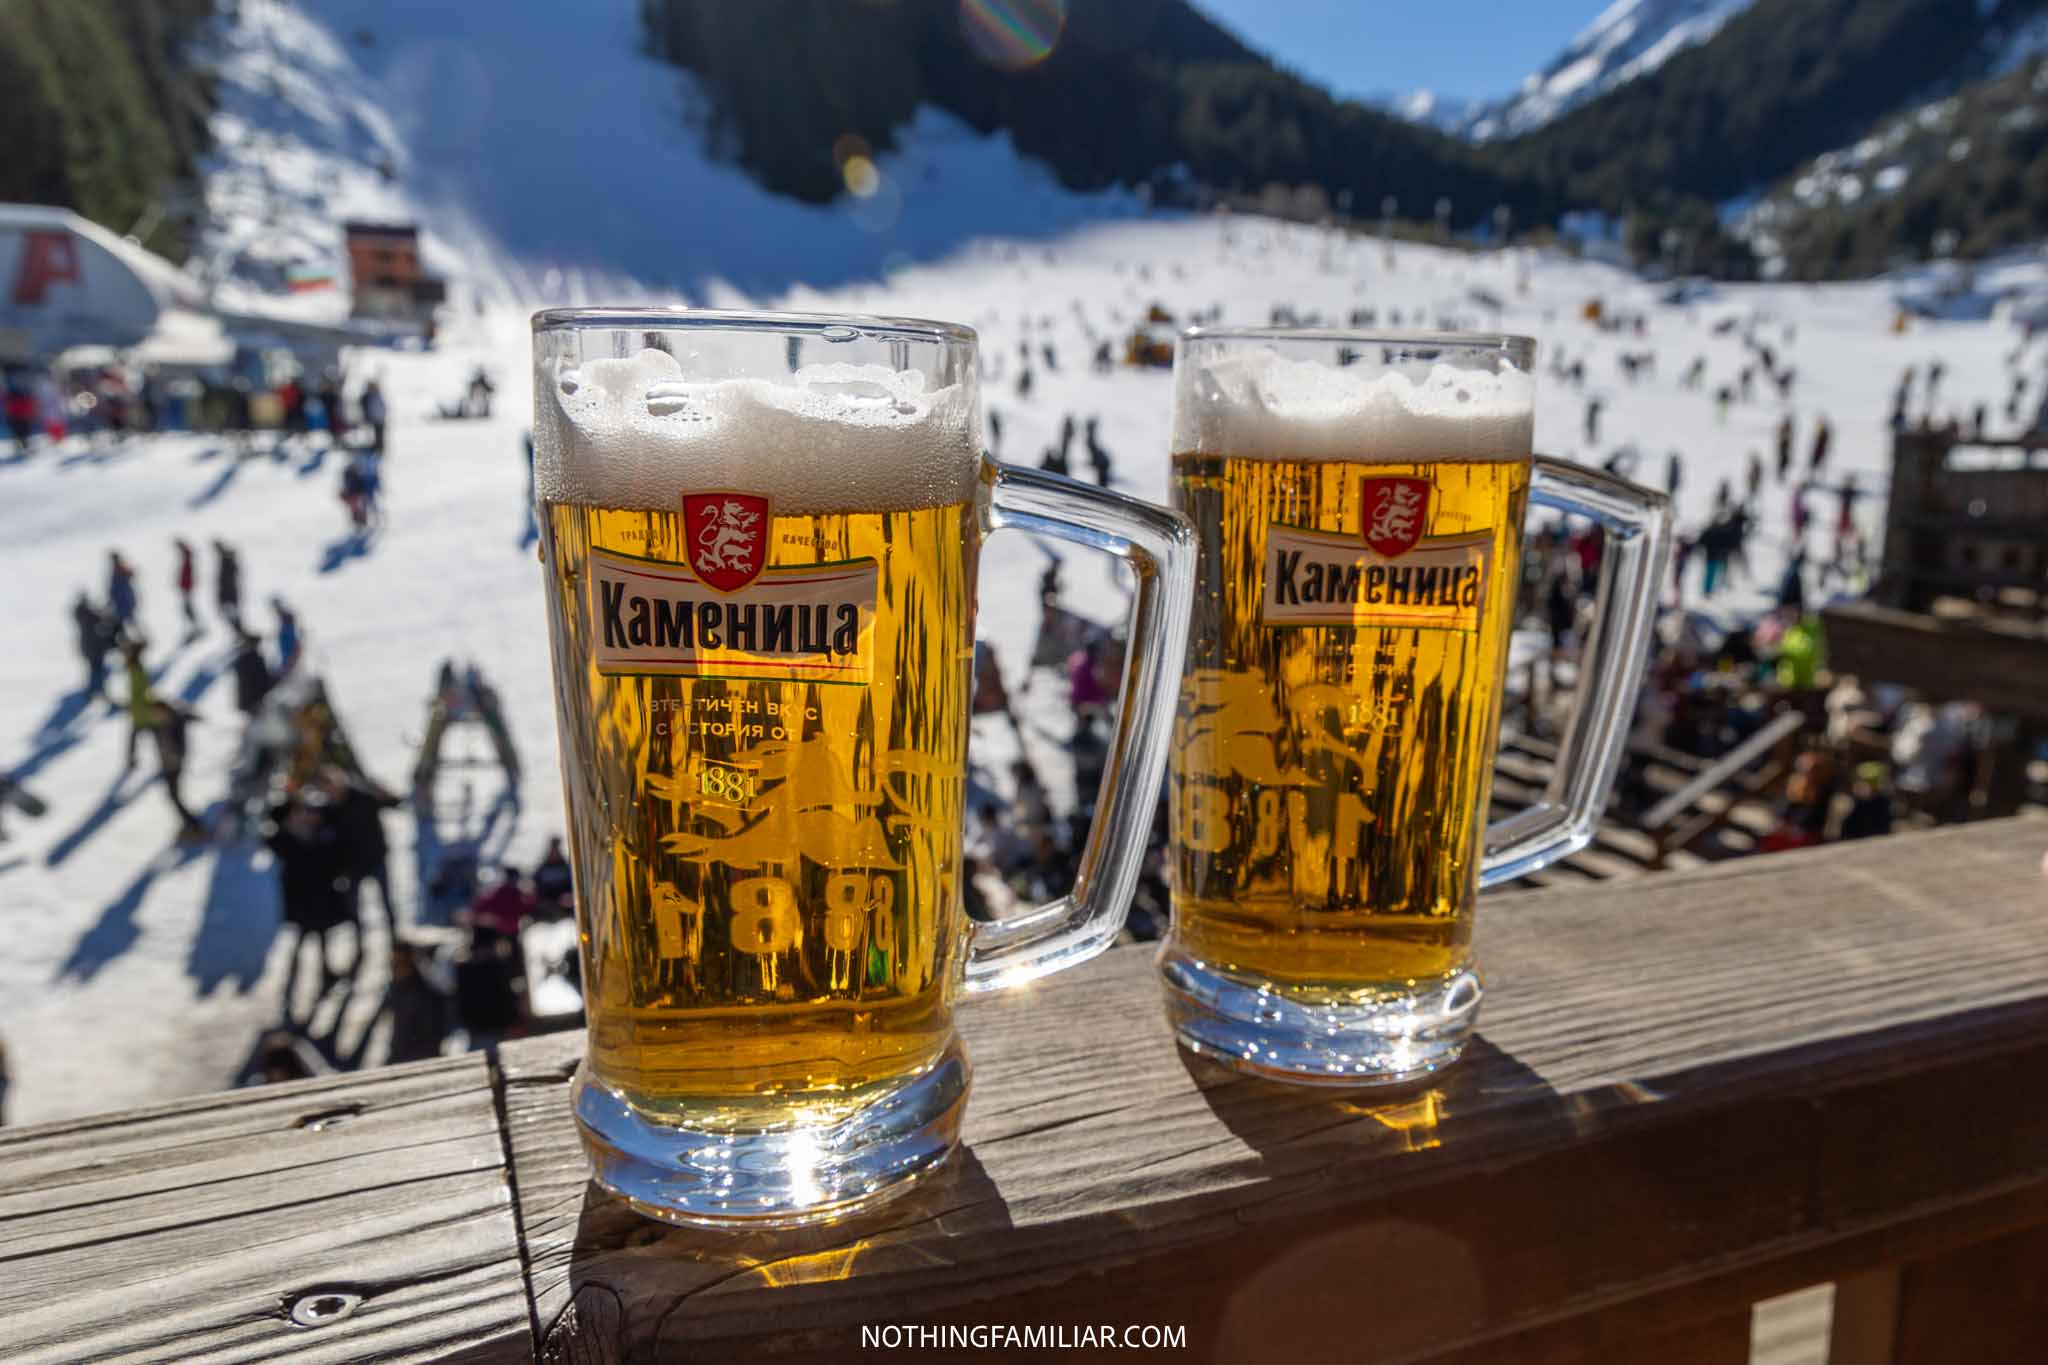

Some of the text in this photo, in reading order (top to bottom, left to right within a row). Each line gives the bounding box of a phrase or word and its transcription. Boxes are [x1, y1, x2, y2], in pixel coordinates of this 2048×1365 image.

[1275, 549, 1481, 611] Каменица
[600, 579, 859, 662] Каменица
[701, 765, 758, 802] 1881
